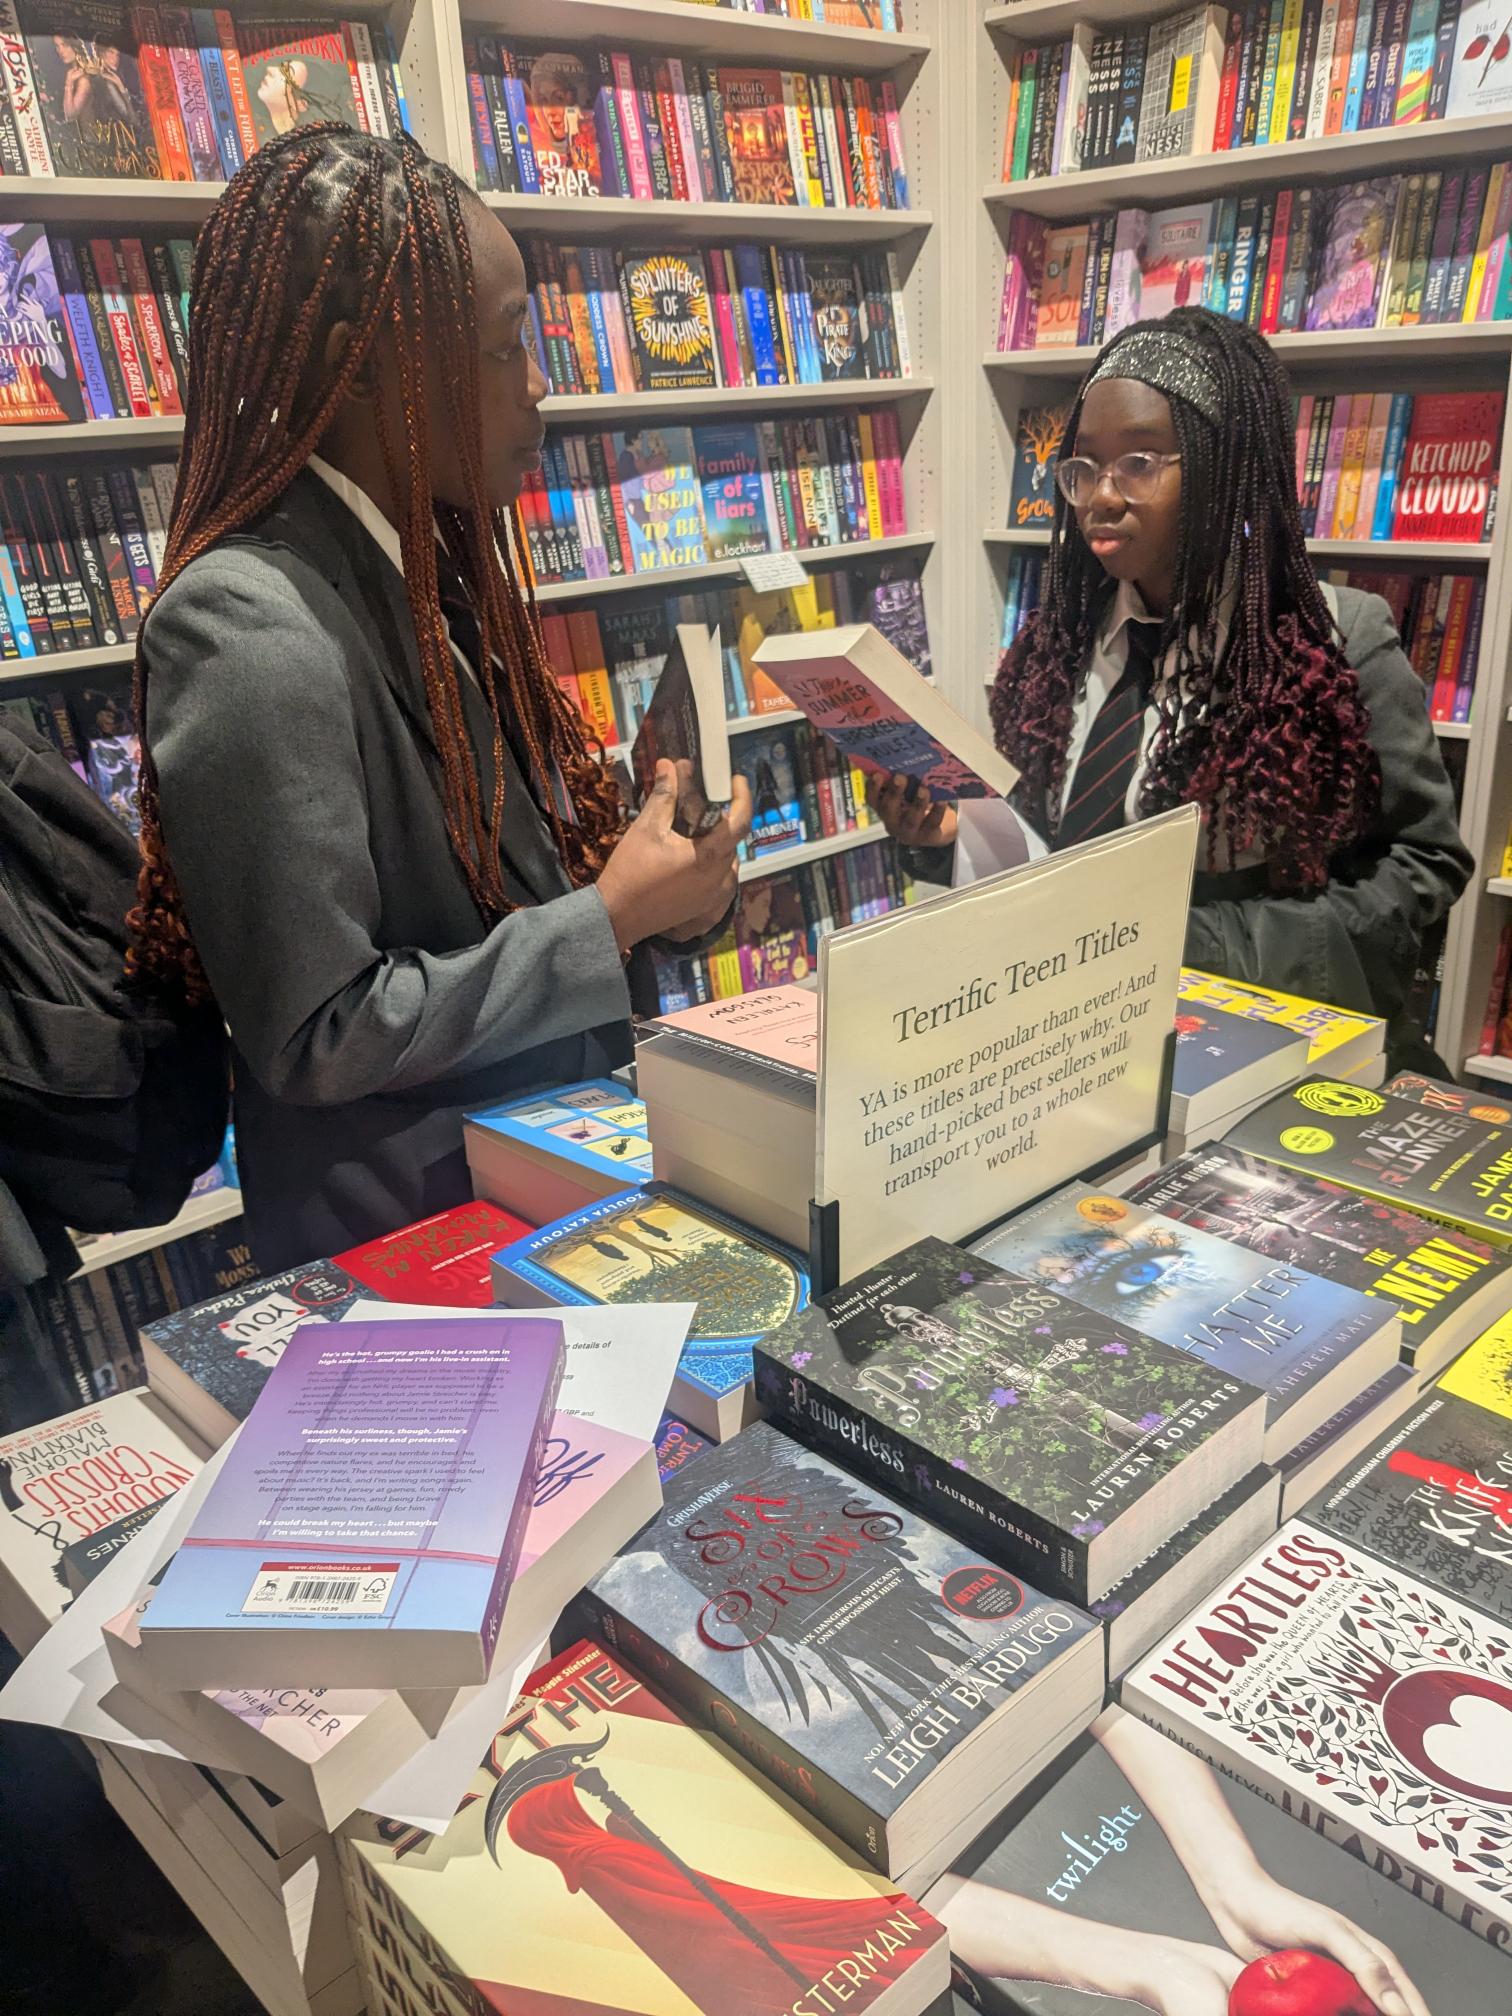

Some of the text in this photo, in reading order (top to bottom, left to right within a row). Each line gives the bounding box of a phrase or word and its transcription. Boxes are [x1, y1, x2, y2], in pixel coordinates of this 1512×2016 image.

[1475, 20, 1497, 34] had
[1089, 44, 1101, 93] NESS
[1099, 42, 1112, 91] NESS
[1110, 40, 1123, 90] NESS
[1311, 76, 1326, 122] SABRIEL
[495, 110, 513, 154] FALLEN
[1145, 135, 1182, 158] NESS
[1146, 125, 1183, 140] PATRICK
[542, 169, 589, 187] STAR
[630, 267, 701, 298] SPLINTERS
[1228, 226, 1253, 313] RINGER
[663, 296, 679, 316] OF
[817, 312, 849, 337] PIRATE
[640, 317, 708, 345] SUNSHINE
[824, 340, 853, 364] KING
[84, 351, 104, 399] KNIGHT
[651, 376, 713, 388] PATRICE LAWRENCE
[663, 464, 691, 481] WE
[698, 451, 758, 476] family
[1411, 440, 1492, 474] KETCHUP
[644, 490, 695, 513] USED
[724, 476, 742, 498] of
[1401, 475, 1486, 515] CLOUDS
[642, 518, 700, 541] TO BE
[715, 499, 755, 520] liars
[131, 544, 149, 566] GETS
[640, 546, 704, 570] MAGIC
[714, 541, 767, 558] e.lockhart
[893, 920, 1140, 1043] Terrific Teen Titles
[708, 994, 782, 1019] GLASGOW
[726, 1001, 805, 1024] KATHLEEN
[859, 965, 1157, 1118] YA is more popular than ever! And
[864, 998, 1151, 1146] these titles are precisely why. Our
[889, 1031, 1129, 1165] hand-picked best sellers will
[884, 1061, 1128, 1197] transport you to a whole new
[1352, 1112, 1441, 1171] MAZE
[1358, 1121, 1390, 1139] THE
[986, 1134, 1039, 1172] world.
[1379, 1115, 1479, 1188] RUNNER
[529, 1191, 647, 1249] ZOULFA KATOUH
[1363, 1247, 1397, 1267] THE
[1364, 1237, 1490, 1325] ENEMY
[235, 1302, 296, 1338] YOU
[827, 1303, 865, 1329] Destined
[866, 1296, 879, 1309] for
[880, 1285, 897, 1297] each
[1173, 1268, 1309, 1360] HATTER
[573, 1341, 612, 1350] details of
[1240, 1313, 1306, 1356] ME
[857, 1286, 1062, 1429] Powerless
[1265, 1313, 1373, 1402] TAHEREH MAFI
[7, 1422, 108, 1469] BLACKMAN
[306, 1437, 361, 1445] surprisingly
[786, 1377, 907, 1474] Powerless
[17, 1437, 112, 1480] MALORIE
[1070, 1382, 1242, 1524] LAUREN ROBERTS
[1326, 1399, 1445, 1510] WINNER GUARDIAN CHILDREN'S FICTION PRIZE
[23, 1445, 153, 1517] CROSSES
[66, 1451, 195, 1538] NOUGHTS
[685, 1479, 804, 1565] SIX
[935, 1479, 1051, 1555] LAUREN ROBERTS
[1419, 1469, 1509, 1547] KNIFE
[290, 1529, 323, 1537] willing
[381, 1529, 418, 1537] chance.
[696, 1499, 904, 1652] CROWS
[952, 1573, 994, 1606] NETFLIX
[799, 1631, 815, 1647] SIX
[814, 1595, 862, 1634] DANGEROUS
[816, 1628, 836, 1645] ONE
[834, 1593, 879, 1630] IMPOSSIBLE
[1150, 1532, 1347, 1708] HEARTLESS
[562, 1649, 601, 1677] Stiefvater
[884, 1721, 907, 1742] NEW
[905, 1697, 932, 1722] YORK
[931, 1674, 959, 1699] TIMES
[955, 1631, 1010, 1676] BESTSELLING
[1008, 1606, 1045, 1634] AUTHOR
[871, 1611, 1076, 1790] LEIGH BARDUGO
[1046, 1804, 1143, 1903] twilight
[783, 1908, 923, 2016] STERMAN
